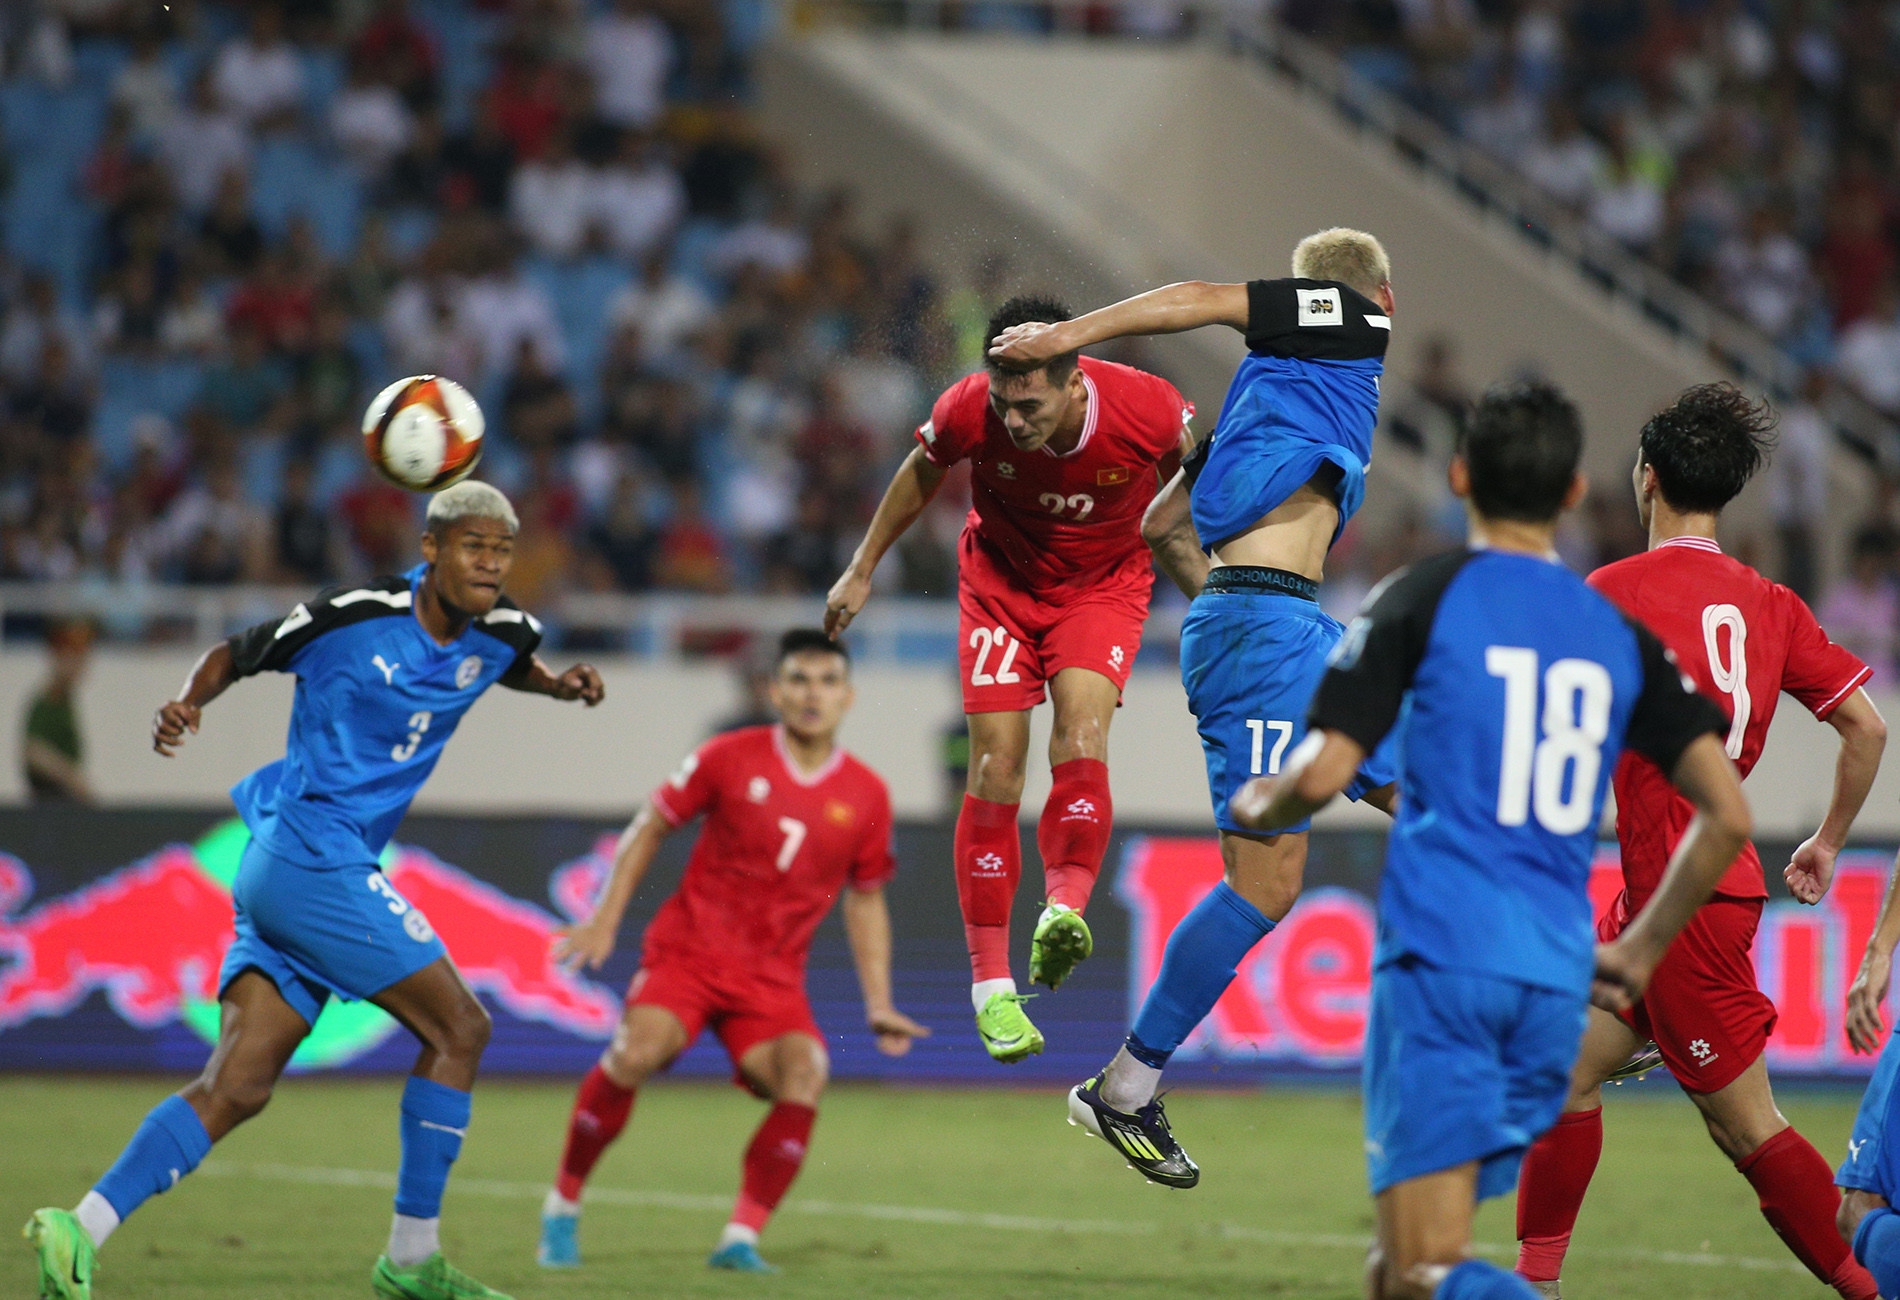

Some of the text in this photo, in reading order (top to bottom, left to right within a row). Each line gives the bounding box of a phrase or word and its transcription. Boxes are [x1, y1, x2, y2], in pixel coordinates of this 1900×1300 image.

[1039, 492, 1094, 520] 22
[969, 625, 1020, 687] 22
[1702, 603, 1751, 760] 9
[391, 710, 432, 763] 3
[1245, 719, 1293, 775] 17
[1484, 645, 1613, 836] 18
[776, 814, 807, 873] 7
[366, 872, 408, 915] 3
